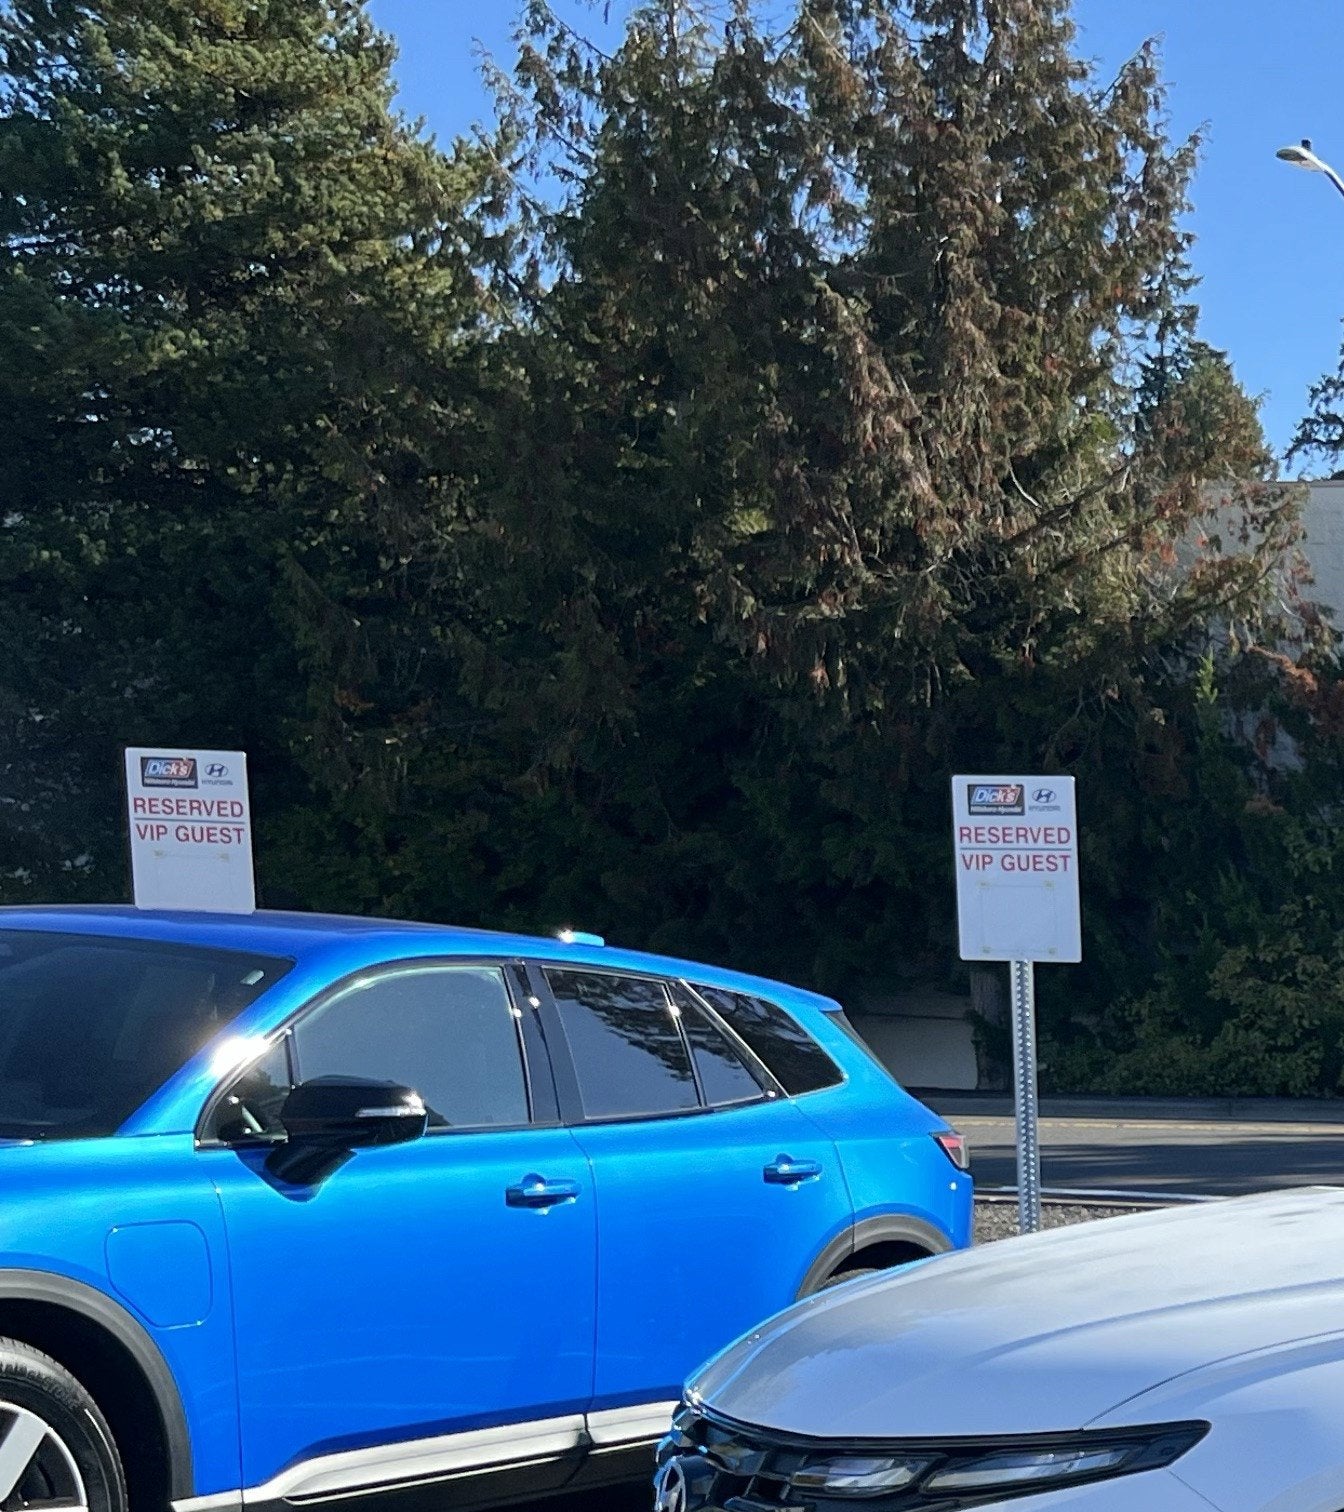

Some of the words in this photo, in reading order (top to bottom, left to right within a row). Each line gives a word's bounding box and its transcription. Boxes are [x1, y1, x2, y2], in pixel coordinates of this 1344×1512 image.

[133, 797, 244, 818] RESERVED
[135, 824, 168, 841] VIP
[175, 825, 245, 844] GUEST
[959, 826, 1071, 845] RESERVED
[961, 854, 993, 871] VIP
[1001, 854, 1071, 872] GUEST
